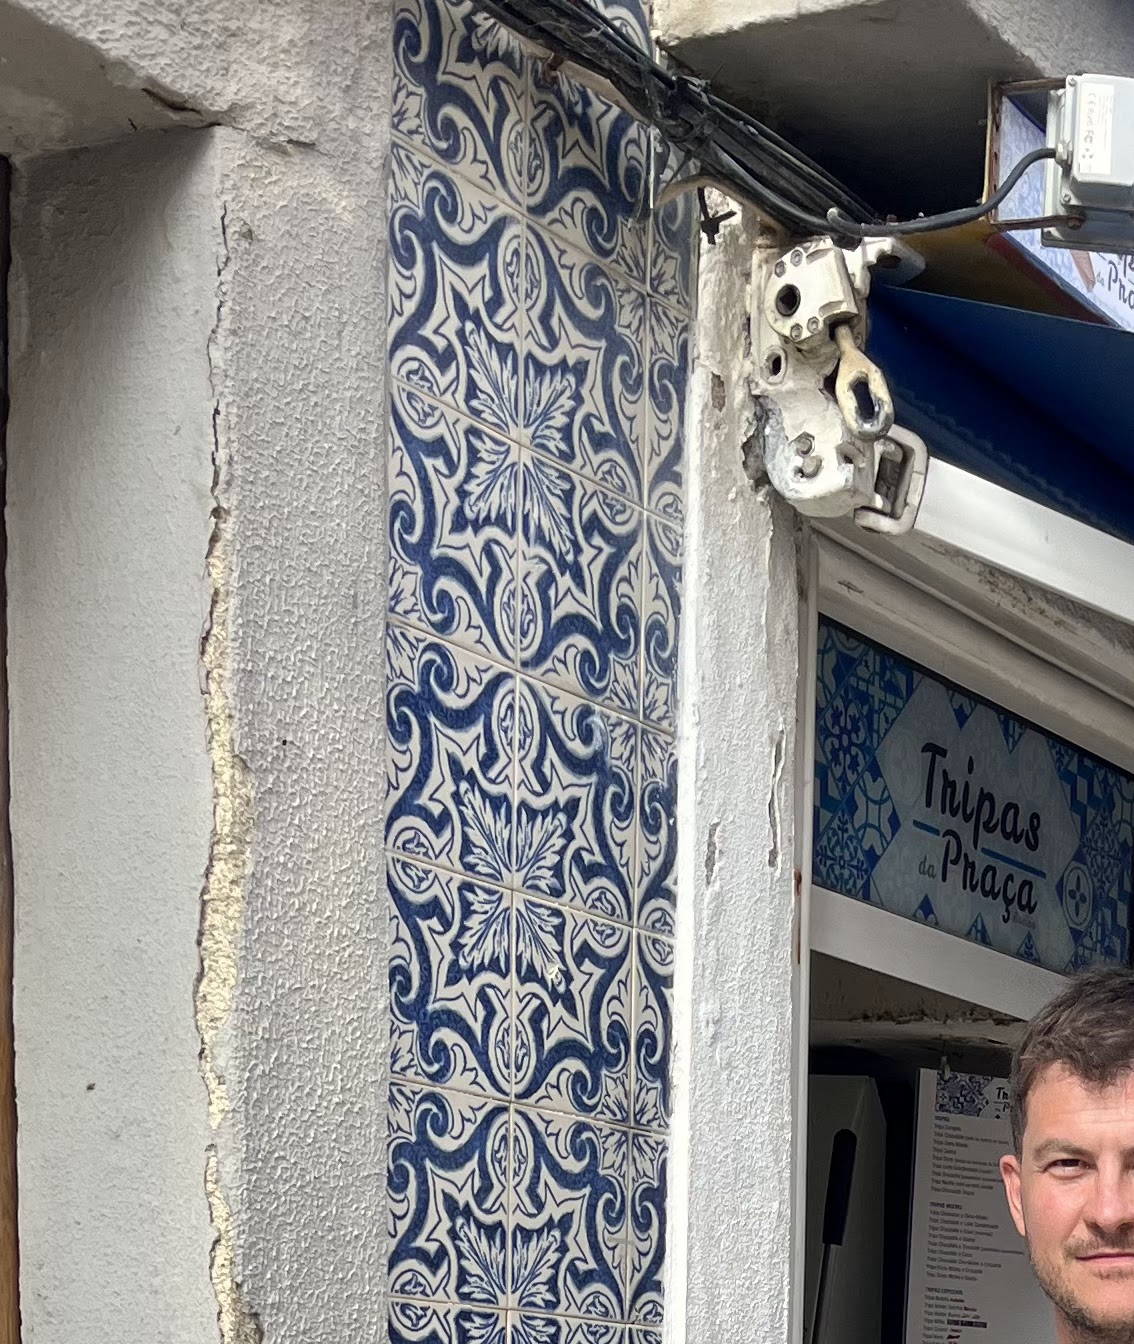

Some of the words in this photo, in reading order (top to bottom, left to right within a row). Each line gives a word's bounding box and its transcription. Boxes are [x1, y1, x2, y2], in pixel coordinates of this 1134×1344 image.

[921, 742, 1041, 851] Tripas
[918, 853, 936, 881] da
[941, 830, 1038, 924] Praça
